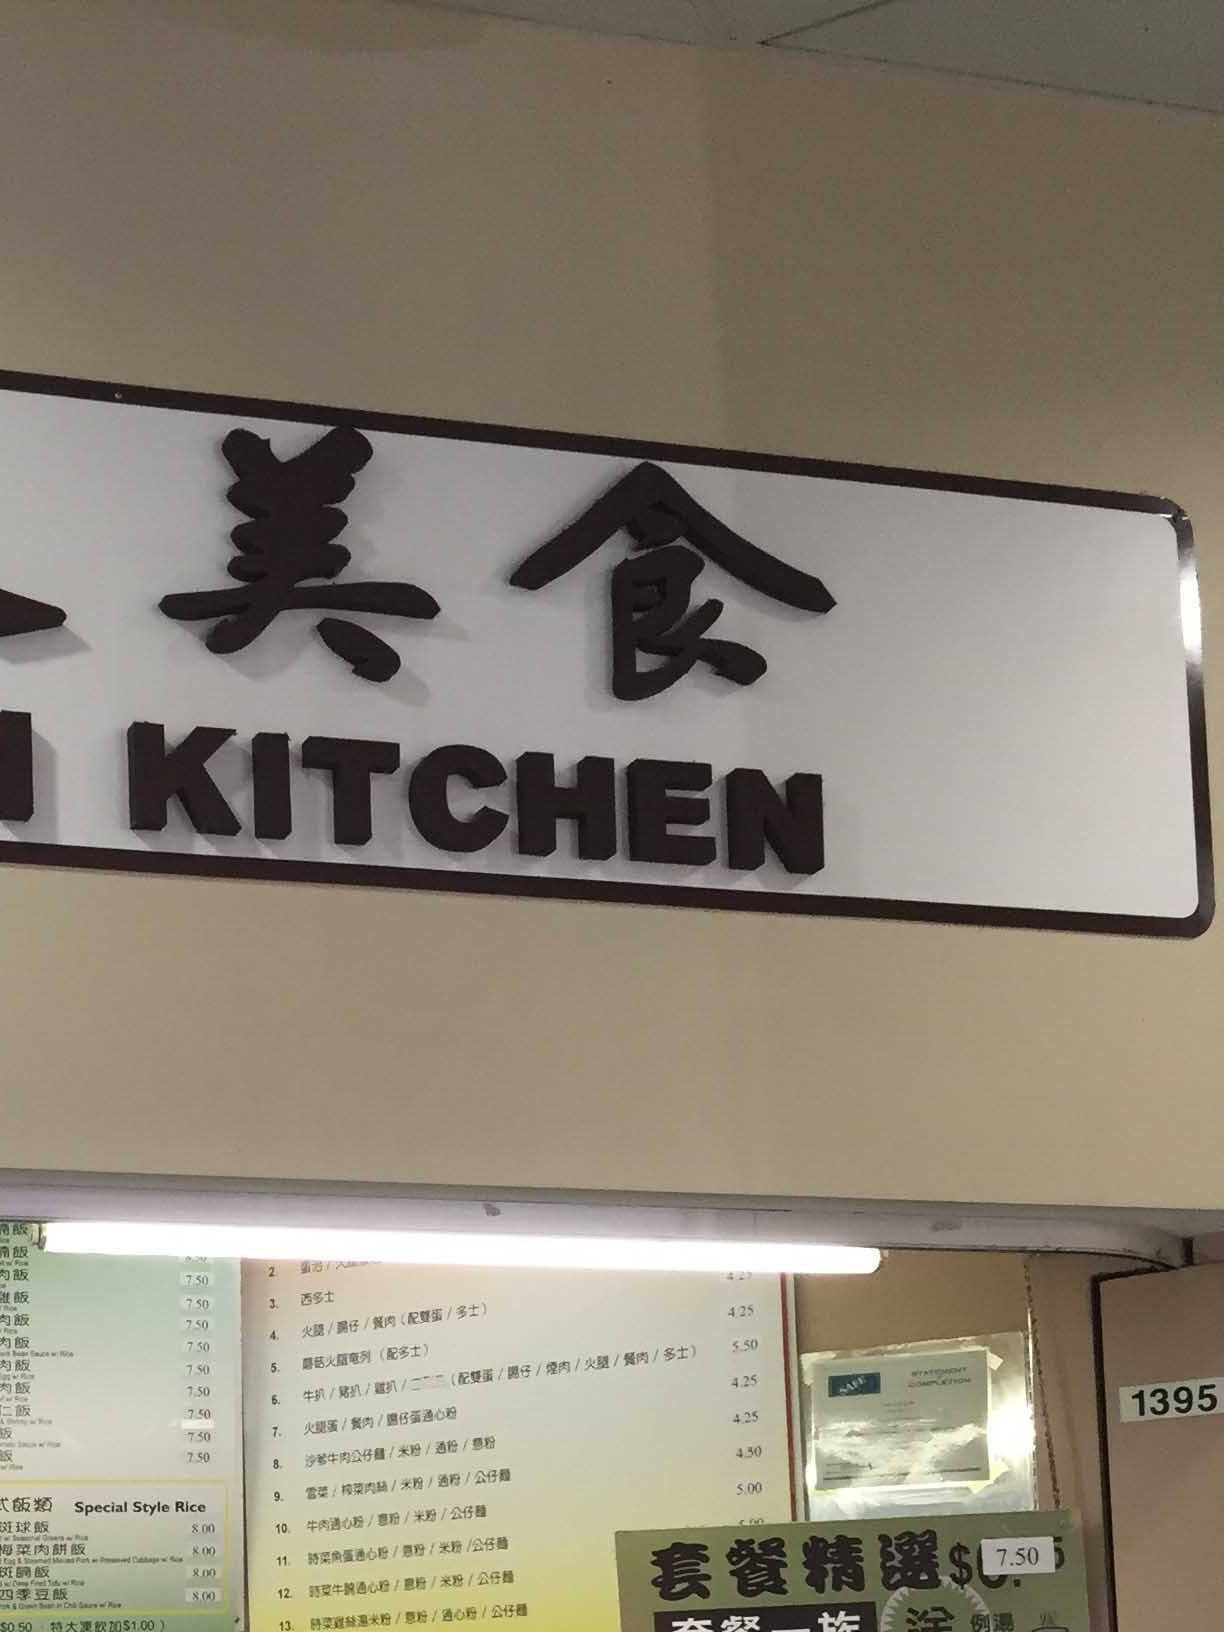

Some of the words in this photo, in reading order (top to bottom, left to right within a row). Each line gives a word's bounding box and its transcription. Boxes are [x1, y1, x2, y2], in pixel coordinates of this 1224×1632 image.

[126, 720, 826, 876] KITCHEN
[186, 1275, 208, 1285] 7.50
[732, 1338, 758, 1352] 5.50
[731, 1374, 757, 1388] 4.25
[1131, 1384, 1217, 1417] 1395
[187, 1431, 210, 1442] 7.50
[187, 1452, 210, 1462] 7.50
[737, 1481, 762, 1495] 5.00
[74, 1501, 127, 1516] Special
[132, 1501, 170, 1516] Style
[175, 1501, 206, 1512] Rice
[191, 1523, 215, 1533] 8.00
[192, 1567, 216, 1577] 8.00
[651, 1530, 939, 1601] 套餐精選
[996, 1546, 1039, 1568] 7.50
[279, 1621, 294, 1631] 13.
